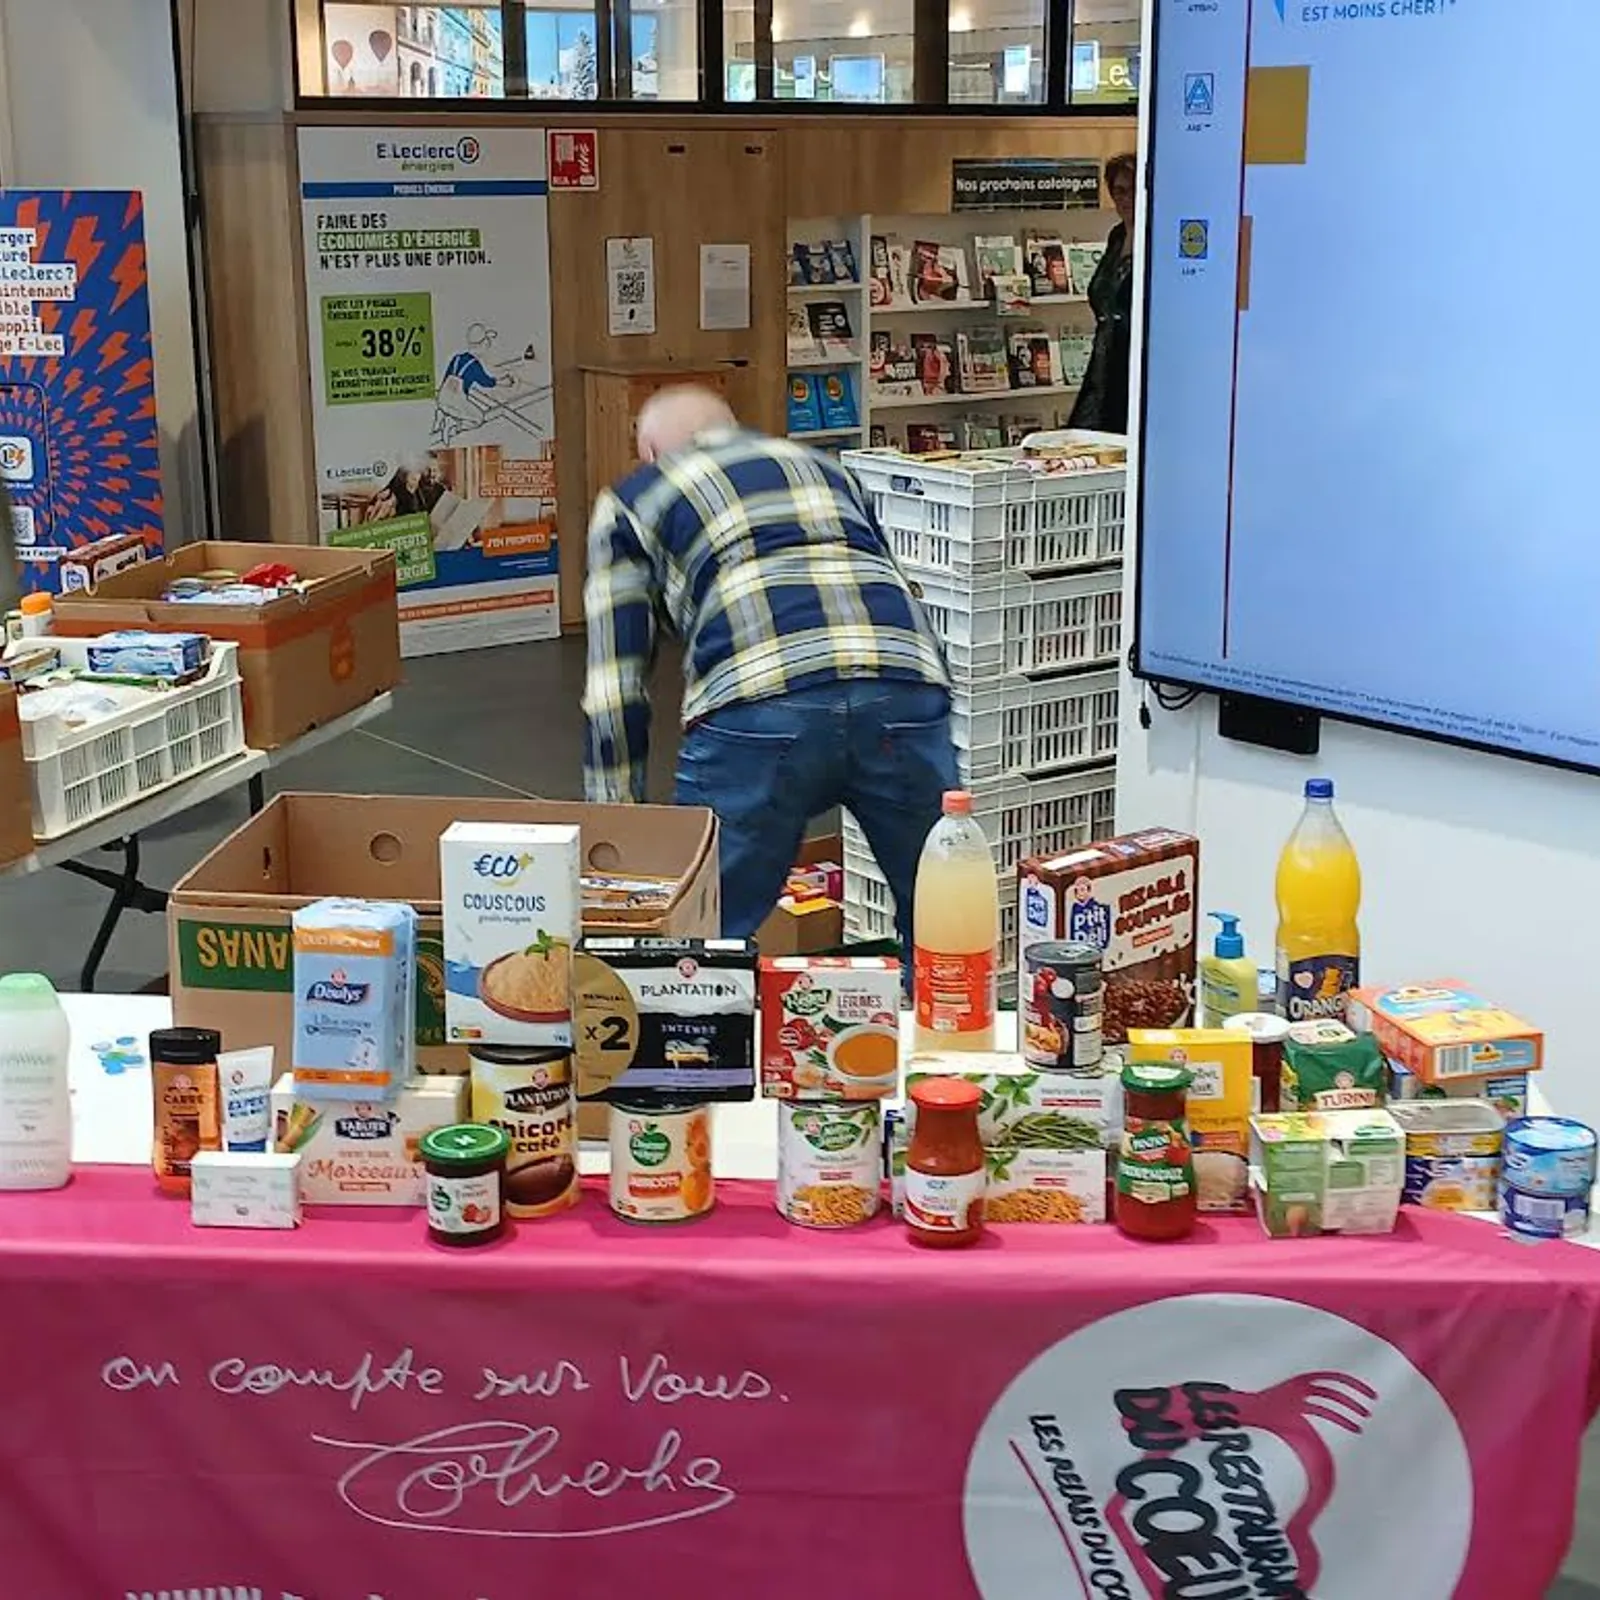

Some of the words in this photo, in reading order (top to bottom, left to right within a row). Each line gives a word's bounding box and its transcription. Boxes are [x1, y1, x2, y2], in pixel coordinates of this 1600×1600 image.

[1302, 6, 1328, 22] EST
[1333, 3, 1386, 19] MOINS
[1391, 0, 1435, 16] CHER
[956, 178, 977, 192] Nos
[979, 177, 1035, 193] prochains
[1037, 177, 1097, 192] catalogues
[318, 214, 357, 229] FAIRE
[362, 213, 387, 229] DES
[0, 232, 34, 244] rger
[0, 251, 28, 263] ure
[320, 253, 360, 269] N'EST
[365, 252, 400, 268] PLUS
[405, 252, 431, 266] UNE
[463, 893, 546, 912] COUSCOUS
[196, 927, 289, 970] ANAS
[640, 984, 737, 997] PLANTATION
[1289, 994, 1347, 1019] ORANG
[308, 1159, 421, 1181] Morceaux
[100, 1356, 180, 1390] on
[208, 1347, 444, 1410] compte
[473, 1359, 592, 1400] sur
[1184, 1381, 1240, 1430] LES
[1029, 1414, 1064, 1453] LES
[1045, 1454, 1099, 1531] RELAIS
[1200, 1430, 1305, 1600] RESTAURAN
[1081, 1531, 1116, 1565] DU
